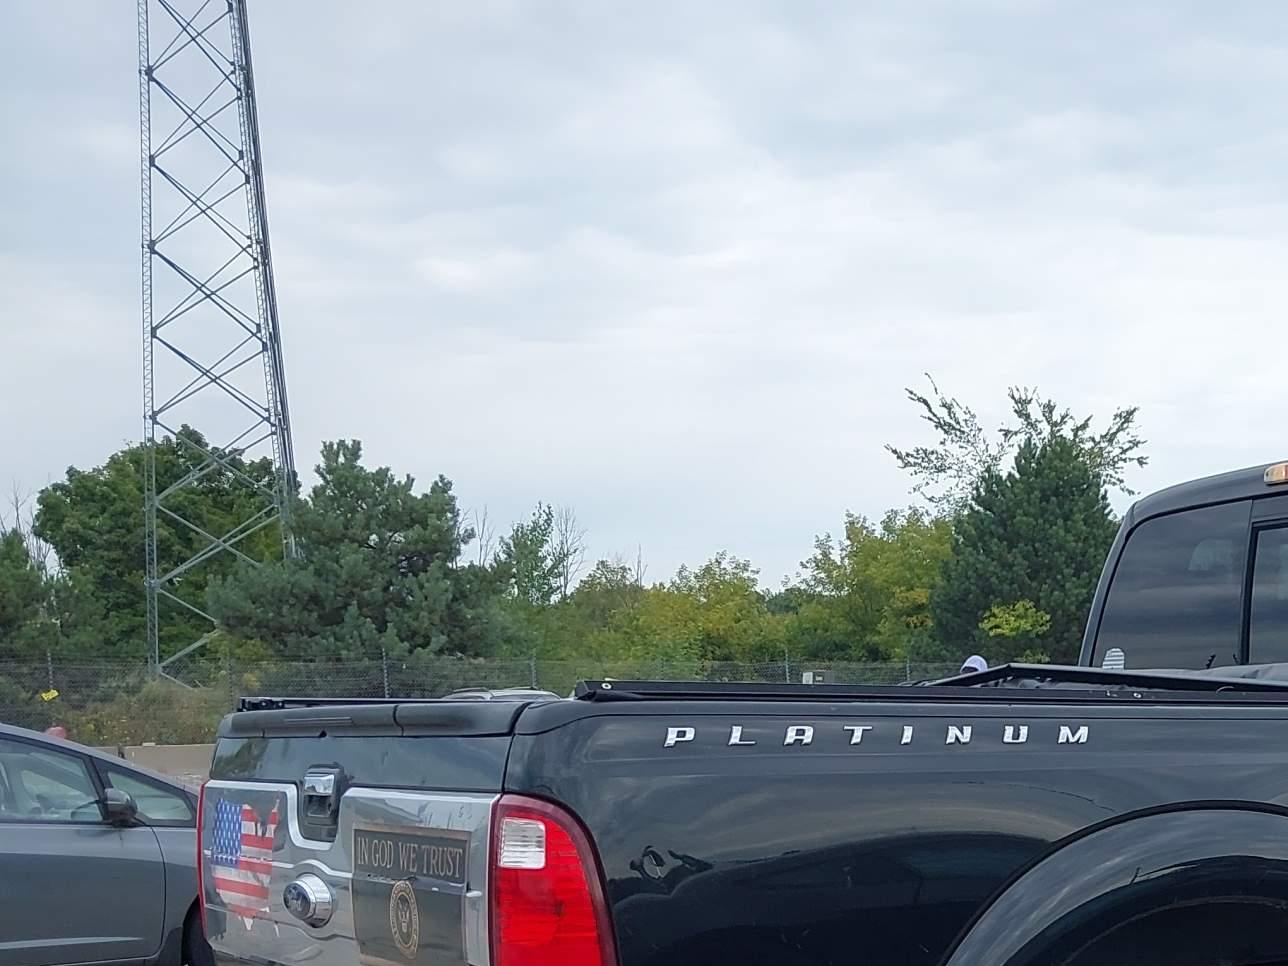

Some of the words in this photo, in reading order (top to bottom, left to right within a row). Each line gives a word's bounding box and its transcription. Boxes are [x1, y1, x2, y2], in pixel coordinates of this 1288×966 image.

[664, 725, 1089, 747] PLATINUM
[358, 836, 369, 864] IN
[371, 839, 394, 868] GOD
[398, 842, 419, 873] WE
[421, 845, 463, 878] TRUST
